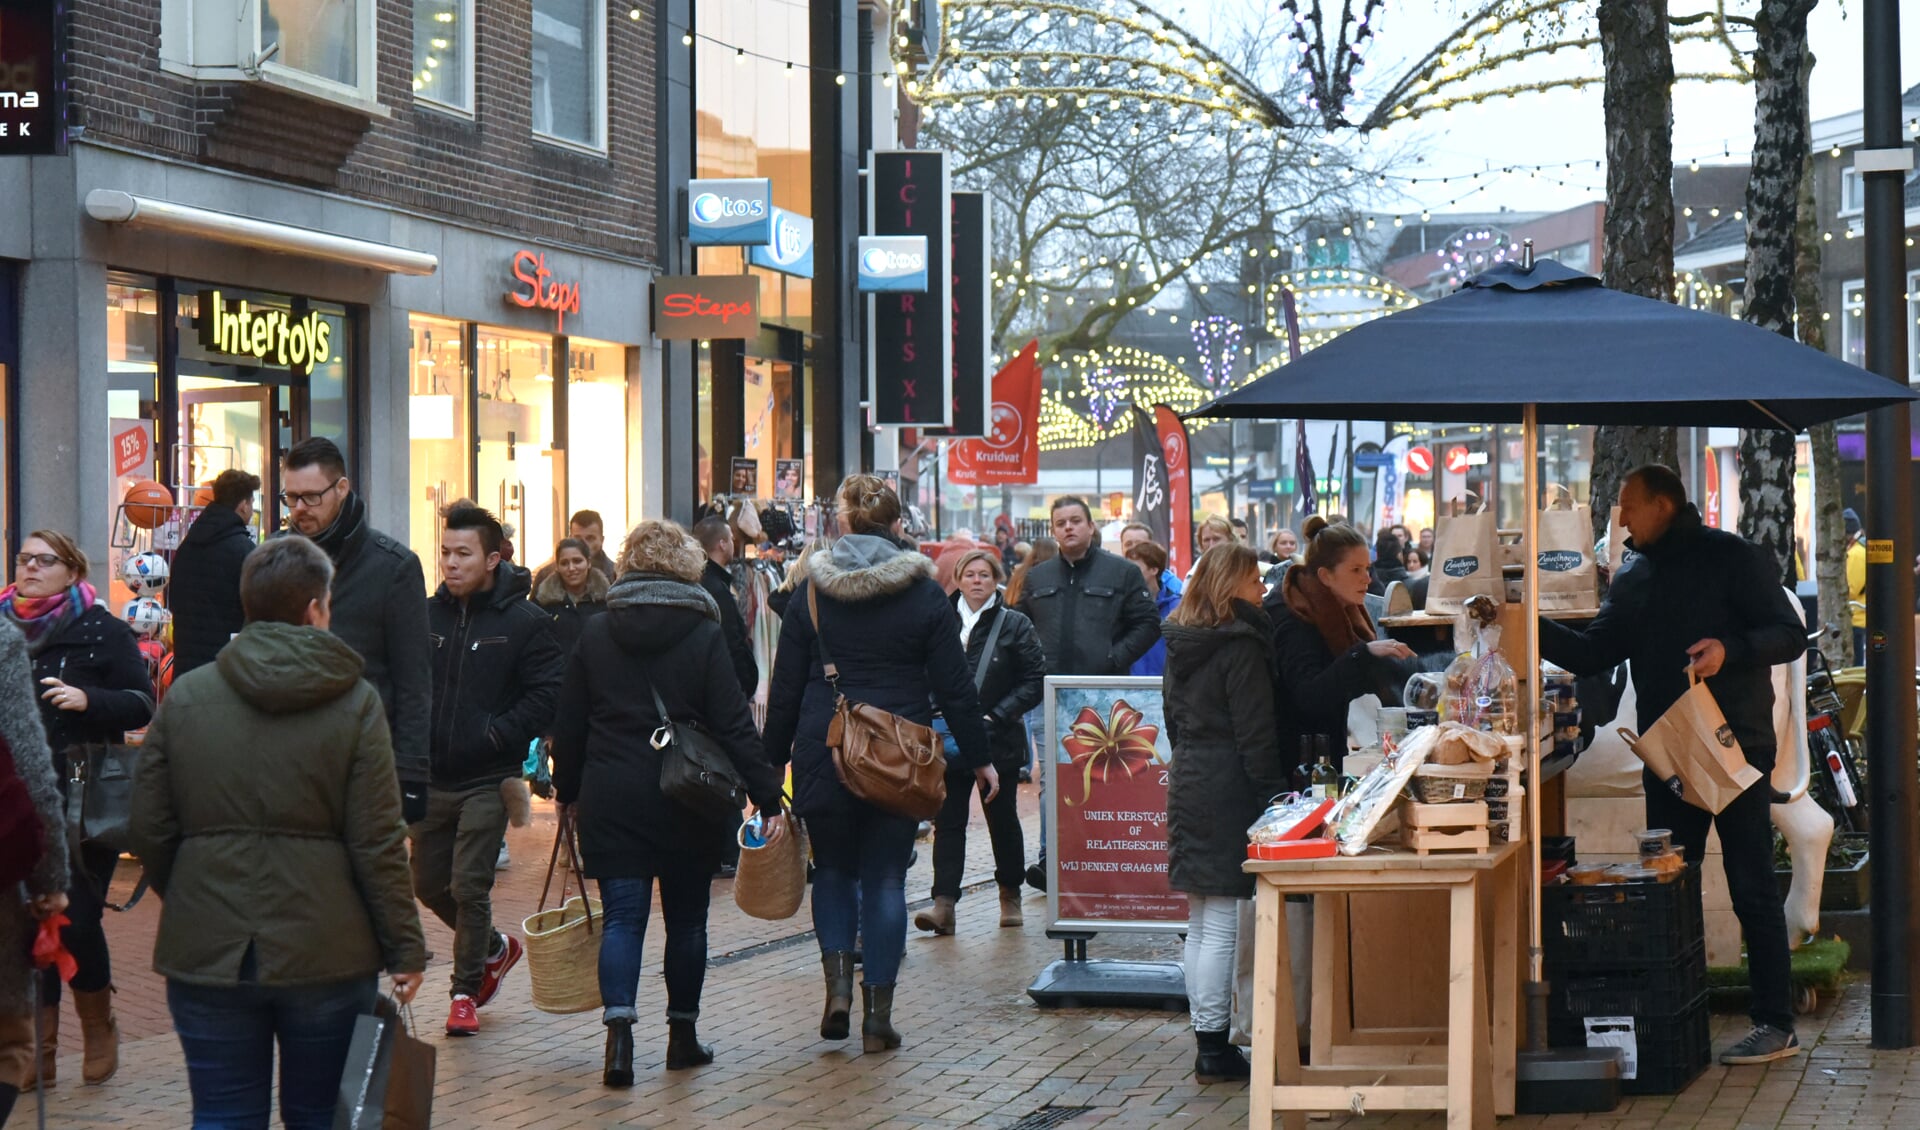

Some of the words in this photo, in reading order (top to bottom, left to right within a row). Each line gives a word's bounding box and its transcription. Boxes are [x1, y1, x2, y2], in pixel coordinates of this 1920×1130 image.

[511, 250, 580, 334] Steps
[662, 293, 752, 325] Steps
[213, 290, 330, 376] Intertoys
[120, 432, 140, 458] 15%
[976, 451, 1020, 463] Kruidvat
[1084, 811, 1115, 821] UNIEK
[1129, 826, 1142, 836] OF
[1086, 840, 1168, 851] RELATIEGESCHE
[1060, 861, 1079, 871] WIJ
[1081, 862, 1119, 872] DENKEN
[1120, 863, 1152, 873] GRAAG
